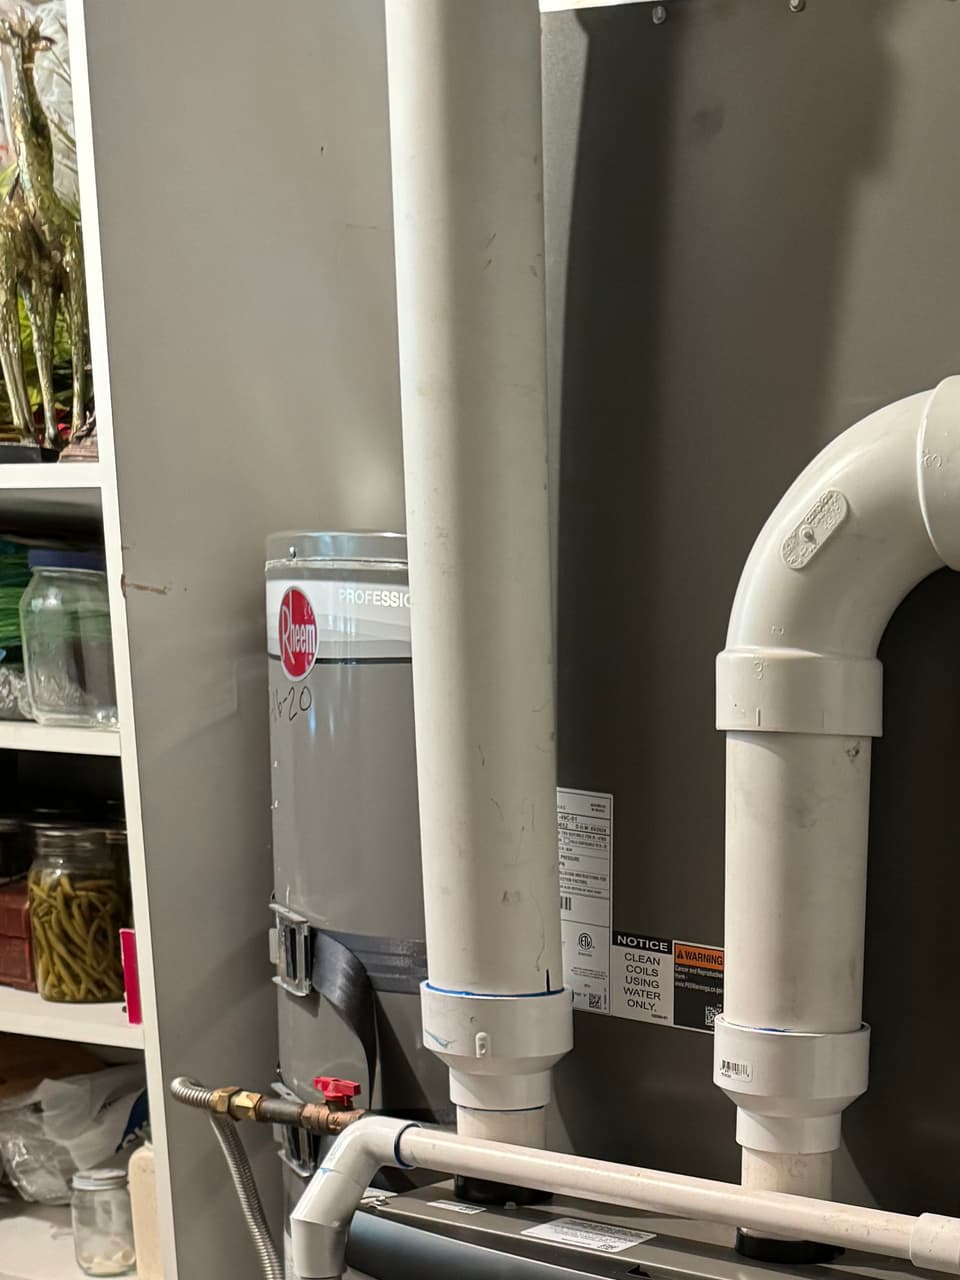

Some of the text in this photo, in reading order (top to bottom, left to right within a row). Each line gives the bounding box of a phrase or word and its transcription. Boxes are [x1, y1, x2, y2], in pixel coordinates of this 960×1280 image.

[282, 591, 316, 665] Rheem
[617, 935, 668, 951] NOTICE
[624, 953, 660, 966] CLEAN
[685, 951, 723, 966] WARNING
[626, 965, 659, 977] COILS
[625, 976, 660, 989] USING
[623, 987, 661, 1000] WATER
[627, 999, 657, 1012] ONLY.
